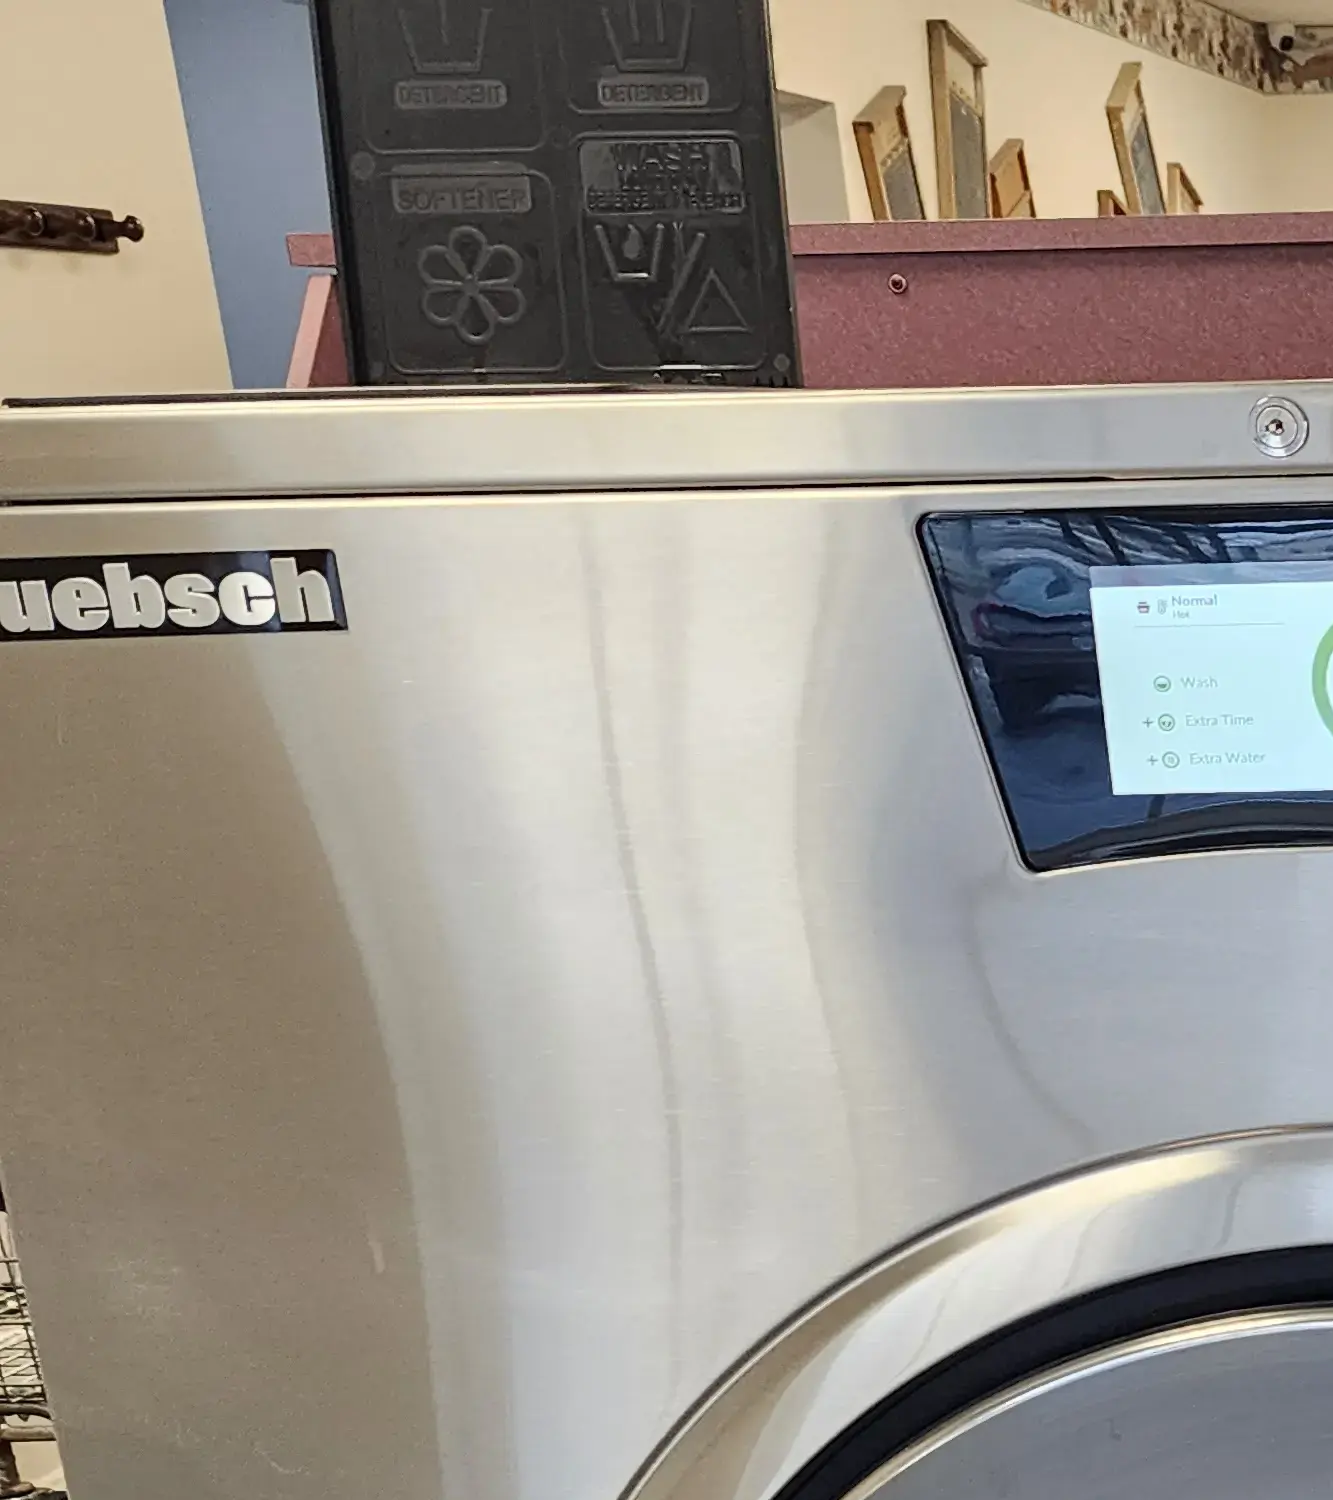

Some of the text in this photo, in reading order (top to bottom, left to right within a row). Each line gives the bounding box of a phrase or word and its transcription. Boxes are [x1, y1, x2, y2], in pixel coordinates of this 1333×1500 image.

[399, 188, 526, 211] SOFTENER
[1171, 594, 1218, 606] Normal
[1180, 675, 1218, 688] Wash
[1185, 713, 1254, 726] Extra Time
[1189, 751, 1266, 765] Extra Water
